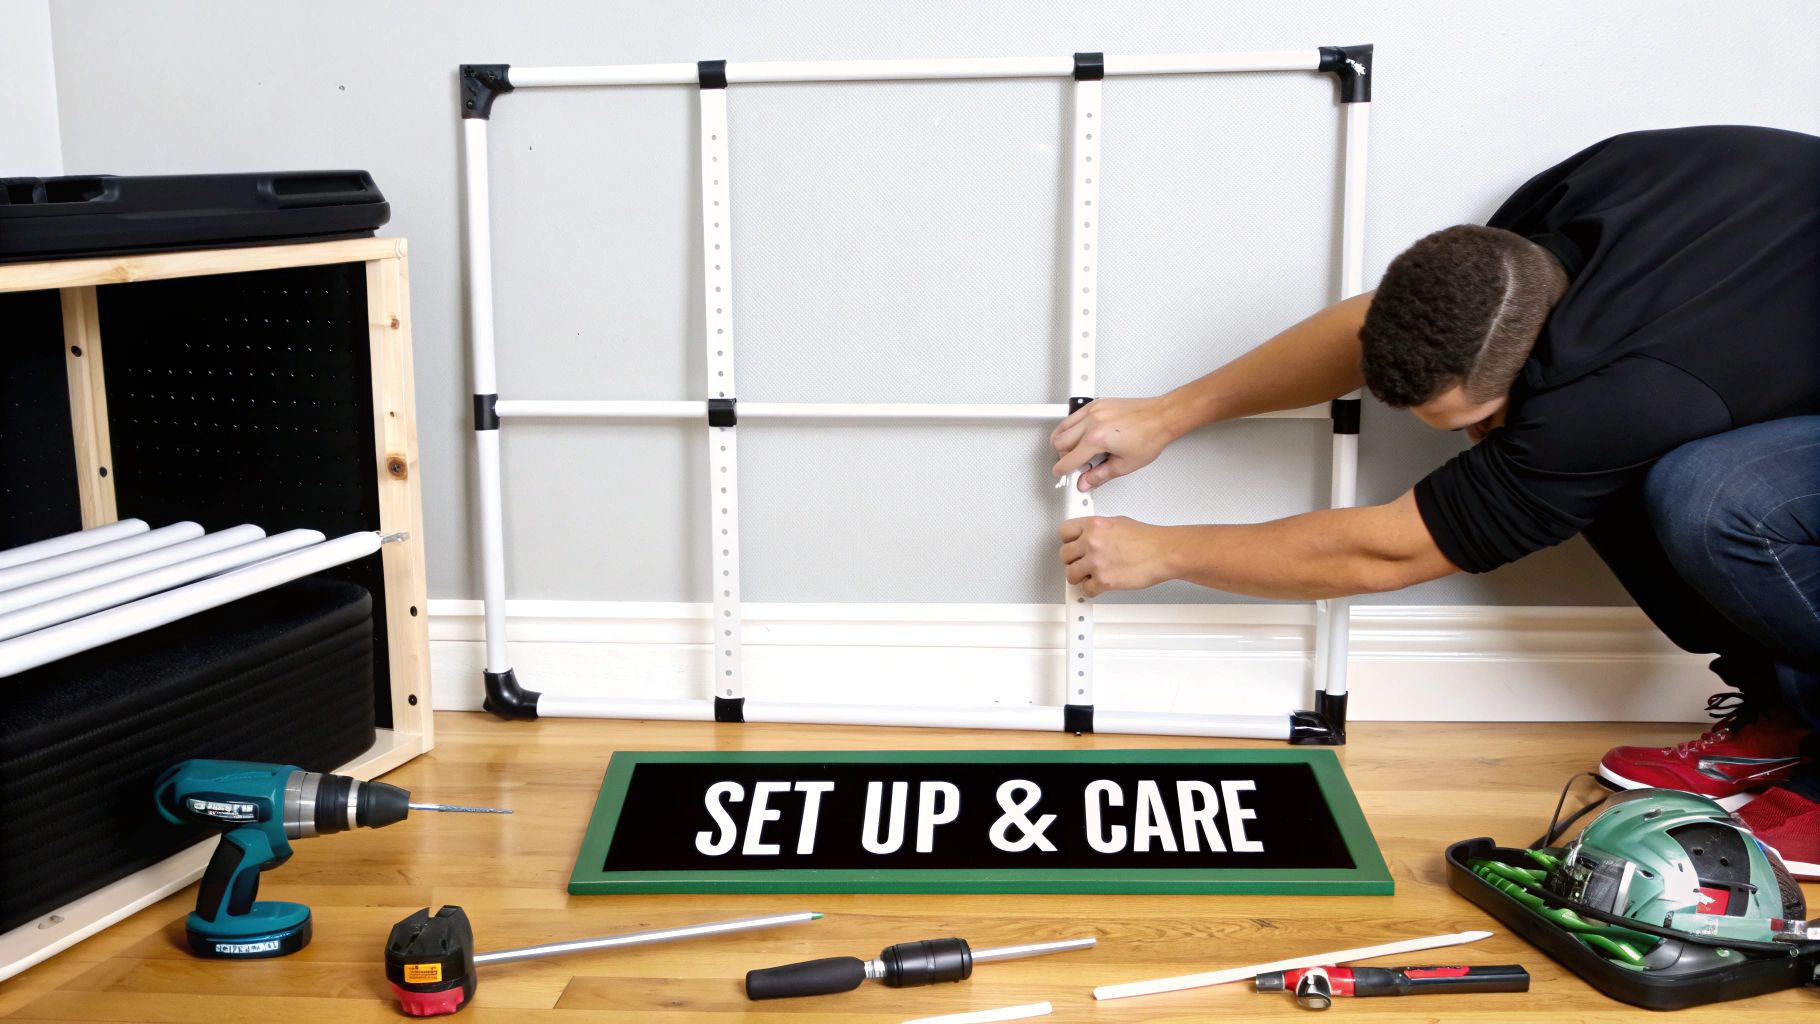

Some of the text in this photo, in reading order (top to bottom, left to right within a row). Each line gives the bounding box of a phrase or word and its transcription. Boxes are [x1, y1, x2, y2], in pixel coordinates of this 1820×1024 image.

[695, 779, 1264, 856] SET UP & CARE
